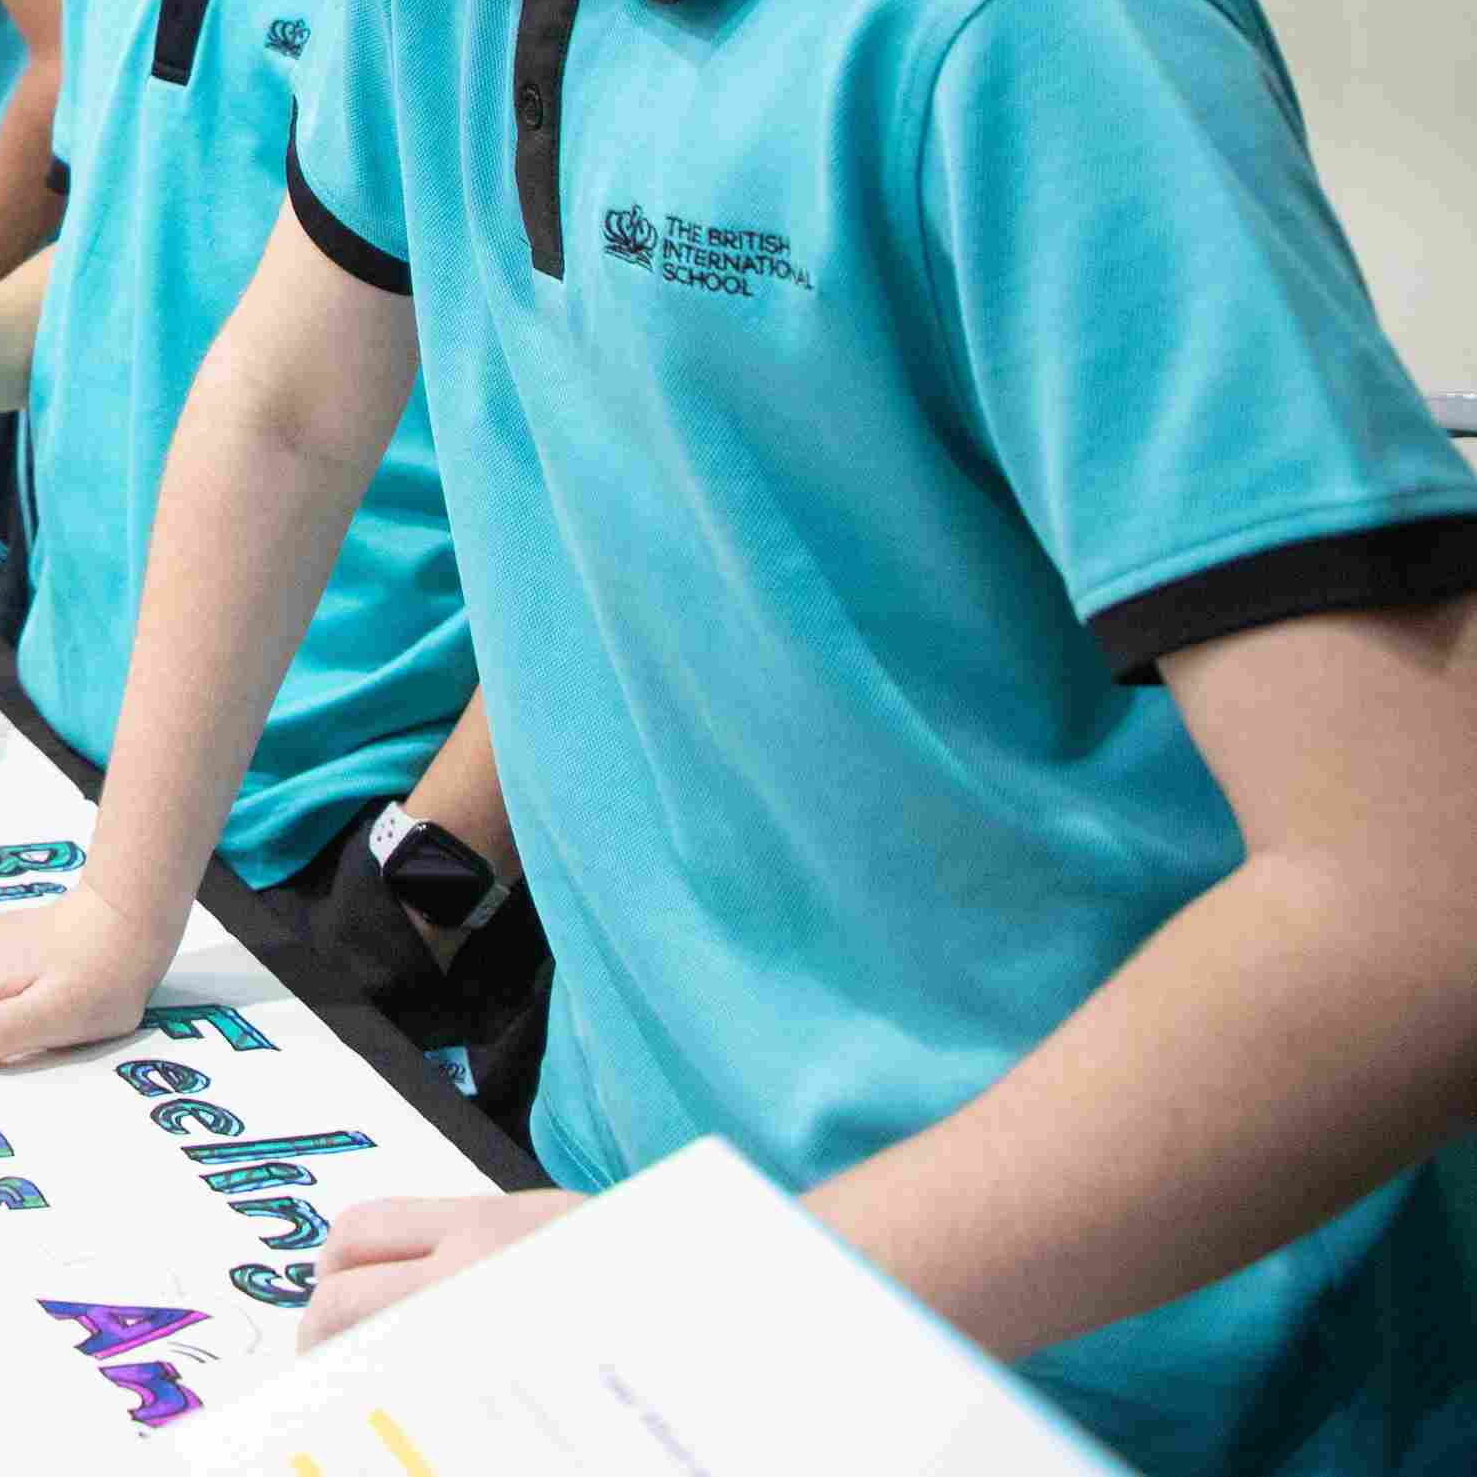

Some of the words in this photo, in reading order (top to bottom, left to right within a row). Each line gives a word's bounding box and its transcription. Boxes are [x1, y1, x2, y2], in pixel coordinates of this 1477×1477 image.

[665, 215, 703, 241] THE
[707, 228, 791, 255] BRITISH
[662, 237, 814, 291] INTERNATIONAL
[662, 263, 754, 297] SCHOOL
[116, 1003, 378, 1308] Feeling
